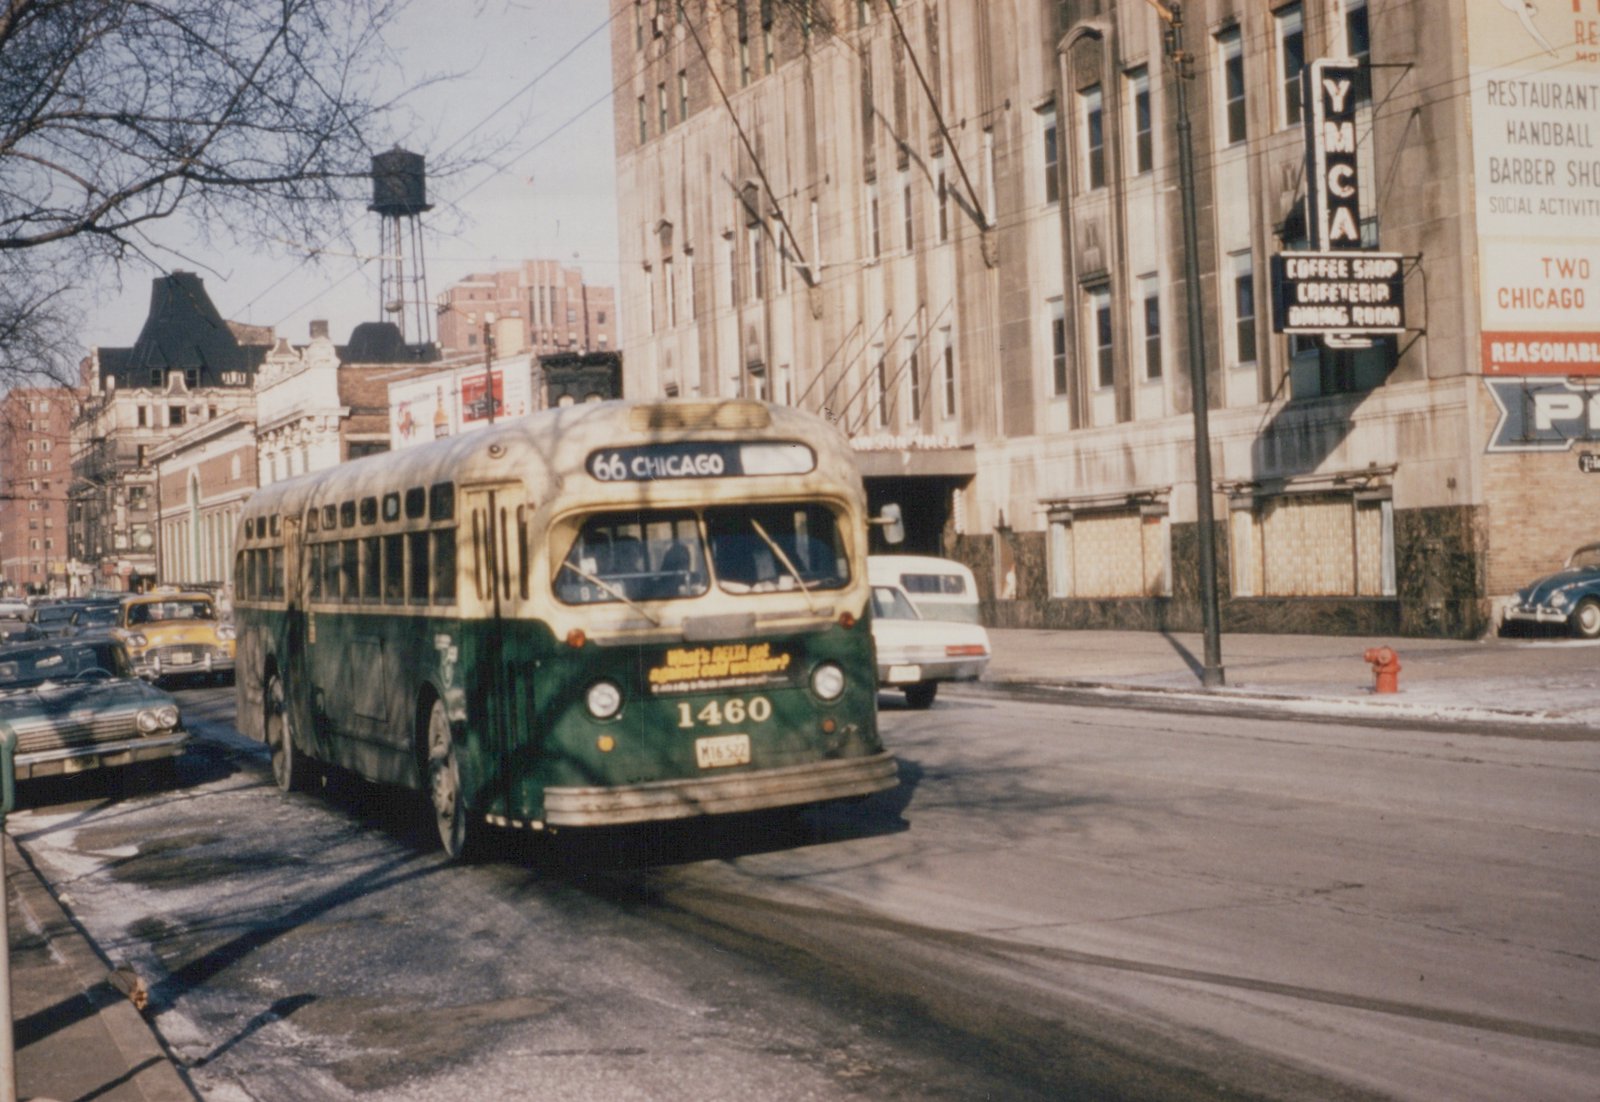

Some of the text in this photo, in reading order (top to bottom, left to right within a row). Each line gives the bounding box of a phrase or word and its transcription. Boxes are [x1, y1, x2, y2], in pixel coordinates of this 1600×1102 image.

[1487, 79, 1600, 111] RESTAURANT
[1506, 120, 1593, 148] HANDBALL
[1323, 79, 1359, 240] YMCA
[1489, 156, 1556, 186] BARBER
[1489, 196, 1533, 215] SOCIAL
[1286, 258, 1398, 279] COFFEE SHOP
[1541, 257, 1590, 279] TWO
[1297, 282, 1390, 303] CAFETERIA
[1497, 287, 1585, 310] CHICAGO
[1352, 306, 1400, 326] ROOM
[1534, 393, 1600, 430] P
[593, 453, 724, 480] 66 CHICAGO
[677, 696, 771, 728] 1460
